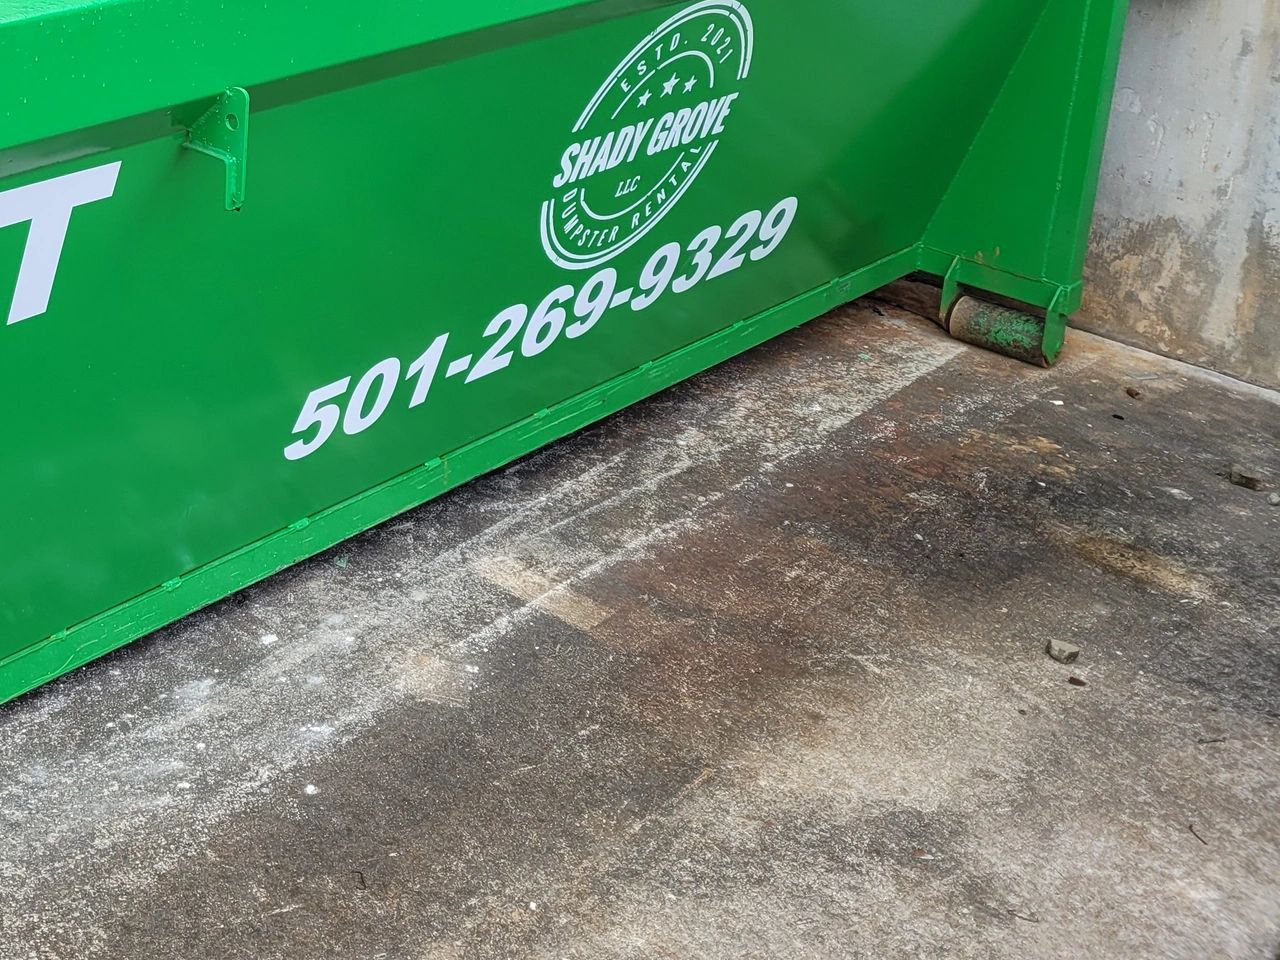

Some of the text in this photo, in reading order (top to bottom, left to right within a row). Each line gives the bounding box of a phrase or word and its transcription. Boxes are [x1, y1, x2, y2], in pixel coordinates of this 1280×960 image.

[700, 23, 734, 64] 2021
[552, 91, 740, 189] SHADY GROVE
[614, 175, 641, 198] LLC
[561, 145, 702, 248] DUMPSTER RENTAL
[283, 196, 799, 461] 501-269-9329
